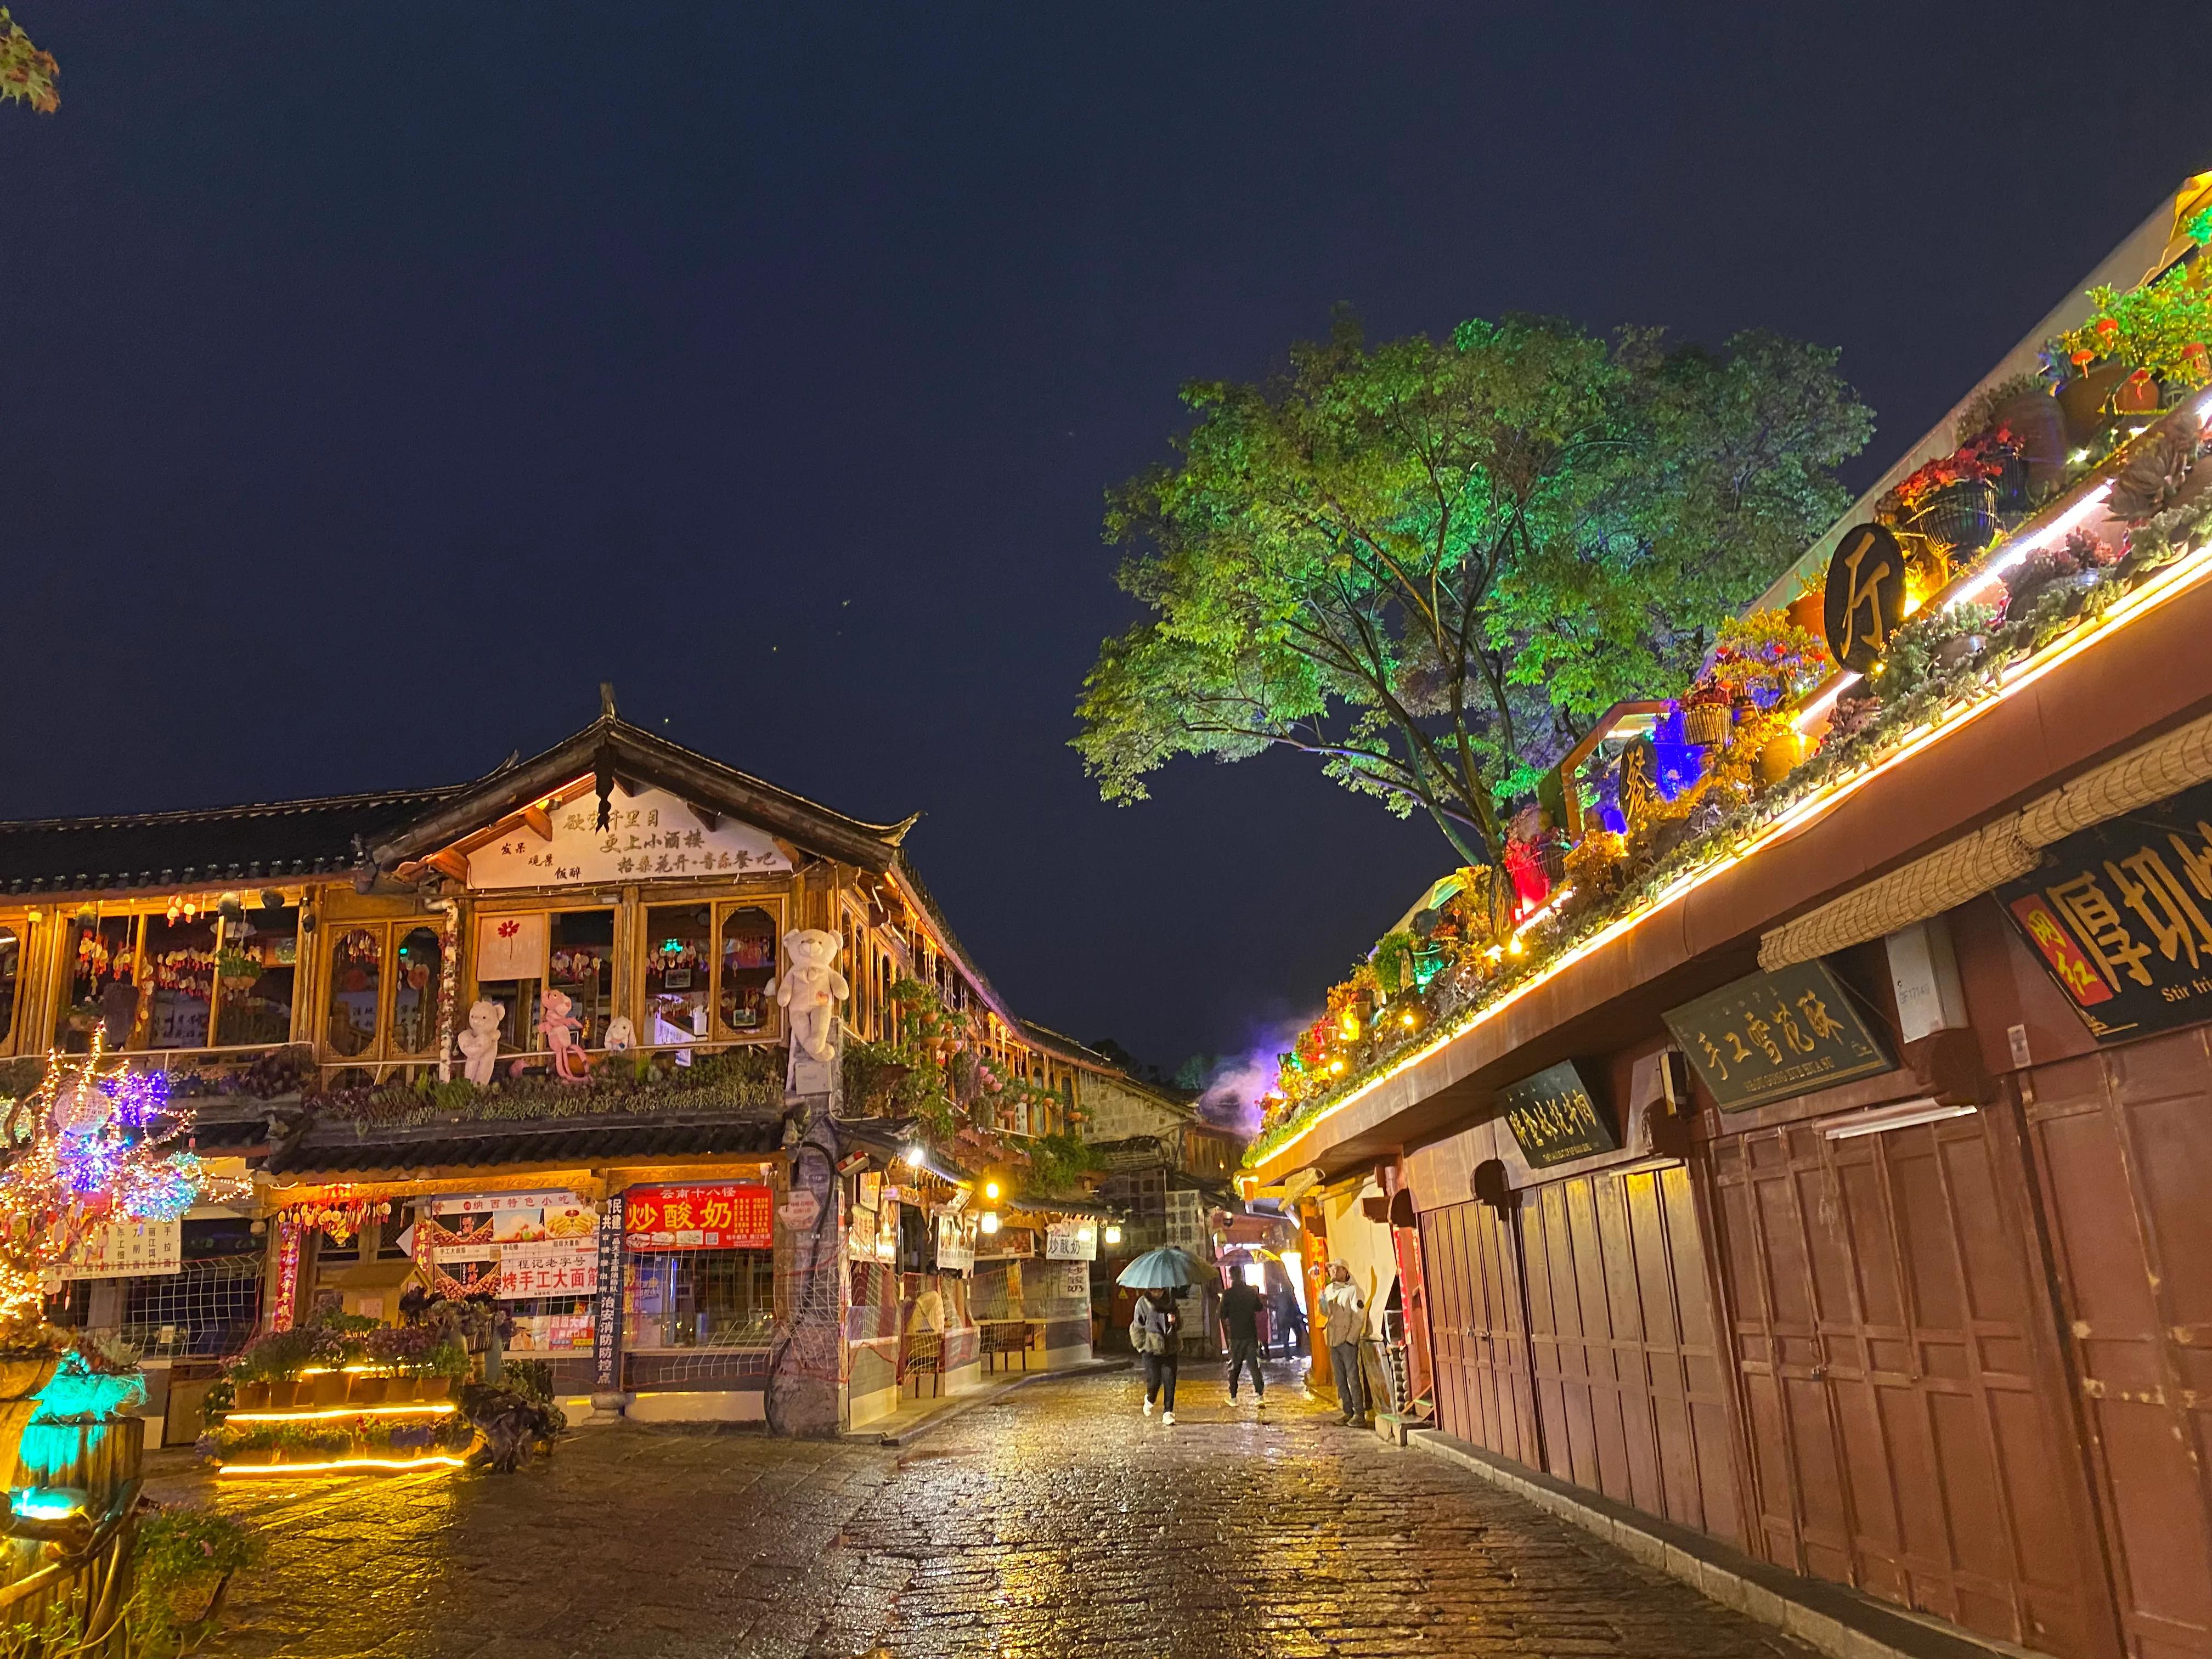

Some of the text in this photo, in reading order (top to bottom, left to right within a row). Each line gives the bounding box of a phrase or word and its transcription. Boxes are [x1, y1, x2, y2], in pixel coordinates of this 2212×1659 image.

[1840, 532, 1890, 660] 厅
[562, 809, 659, 832] 欲穷千里目
[500, 842, 526, 856] 发呆
[600, 828, 705, 854] 更上小酒楼
[527, 853, 554, 867] 观景
[2028, 909, 2098, 997] 网红
[2162, 984, 2191, 1003] Stir
[1697, 989, 1845, 1081] 手工雪花酥
[472, 1195, 570, 1210] 纳西特色小吃
[660, 1187, 737, 1200] 云南十八怪
[625, 1198, 732, 1231] 炒酸奶
[1047, 1237, 1080, 1255] 炒酸奶
[501, 1266, 597, 1292] 烤手工大面筋
[597, 1296, 615, 1385] 治安消防防控点
